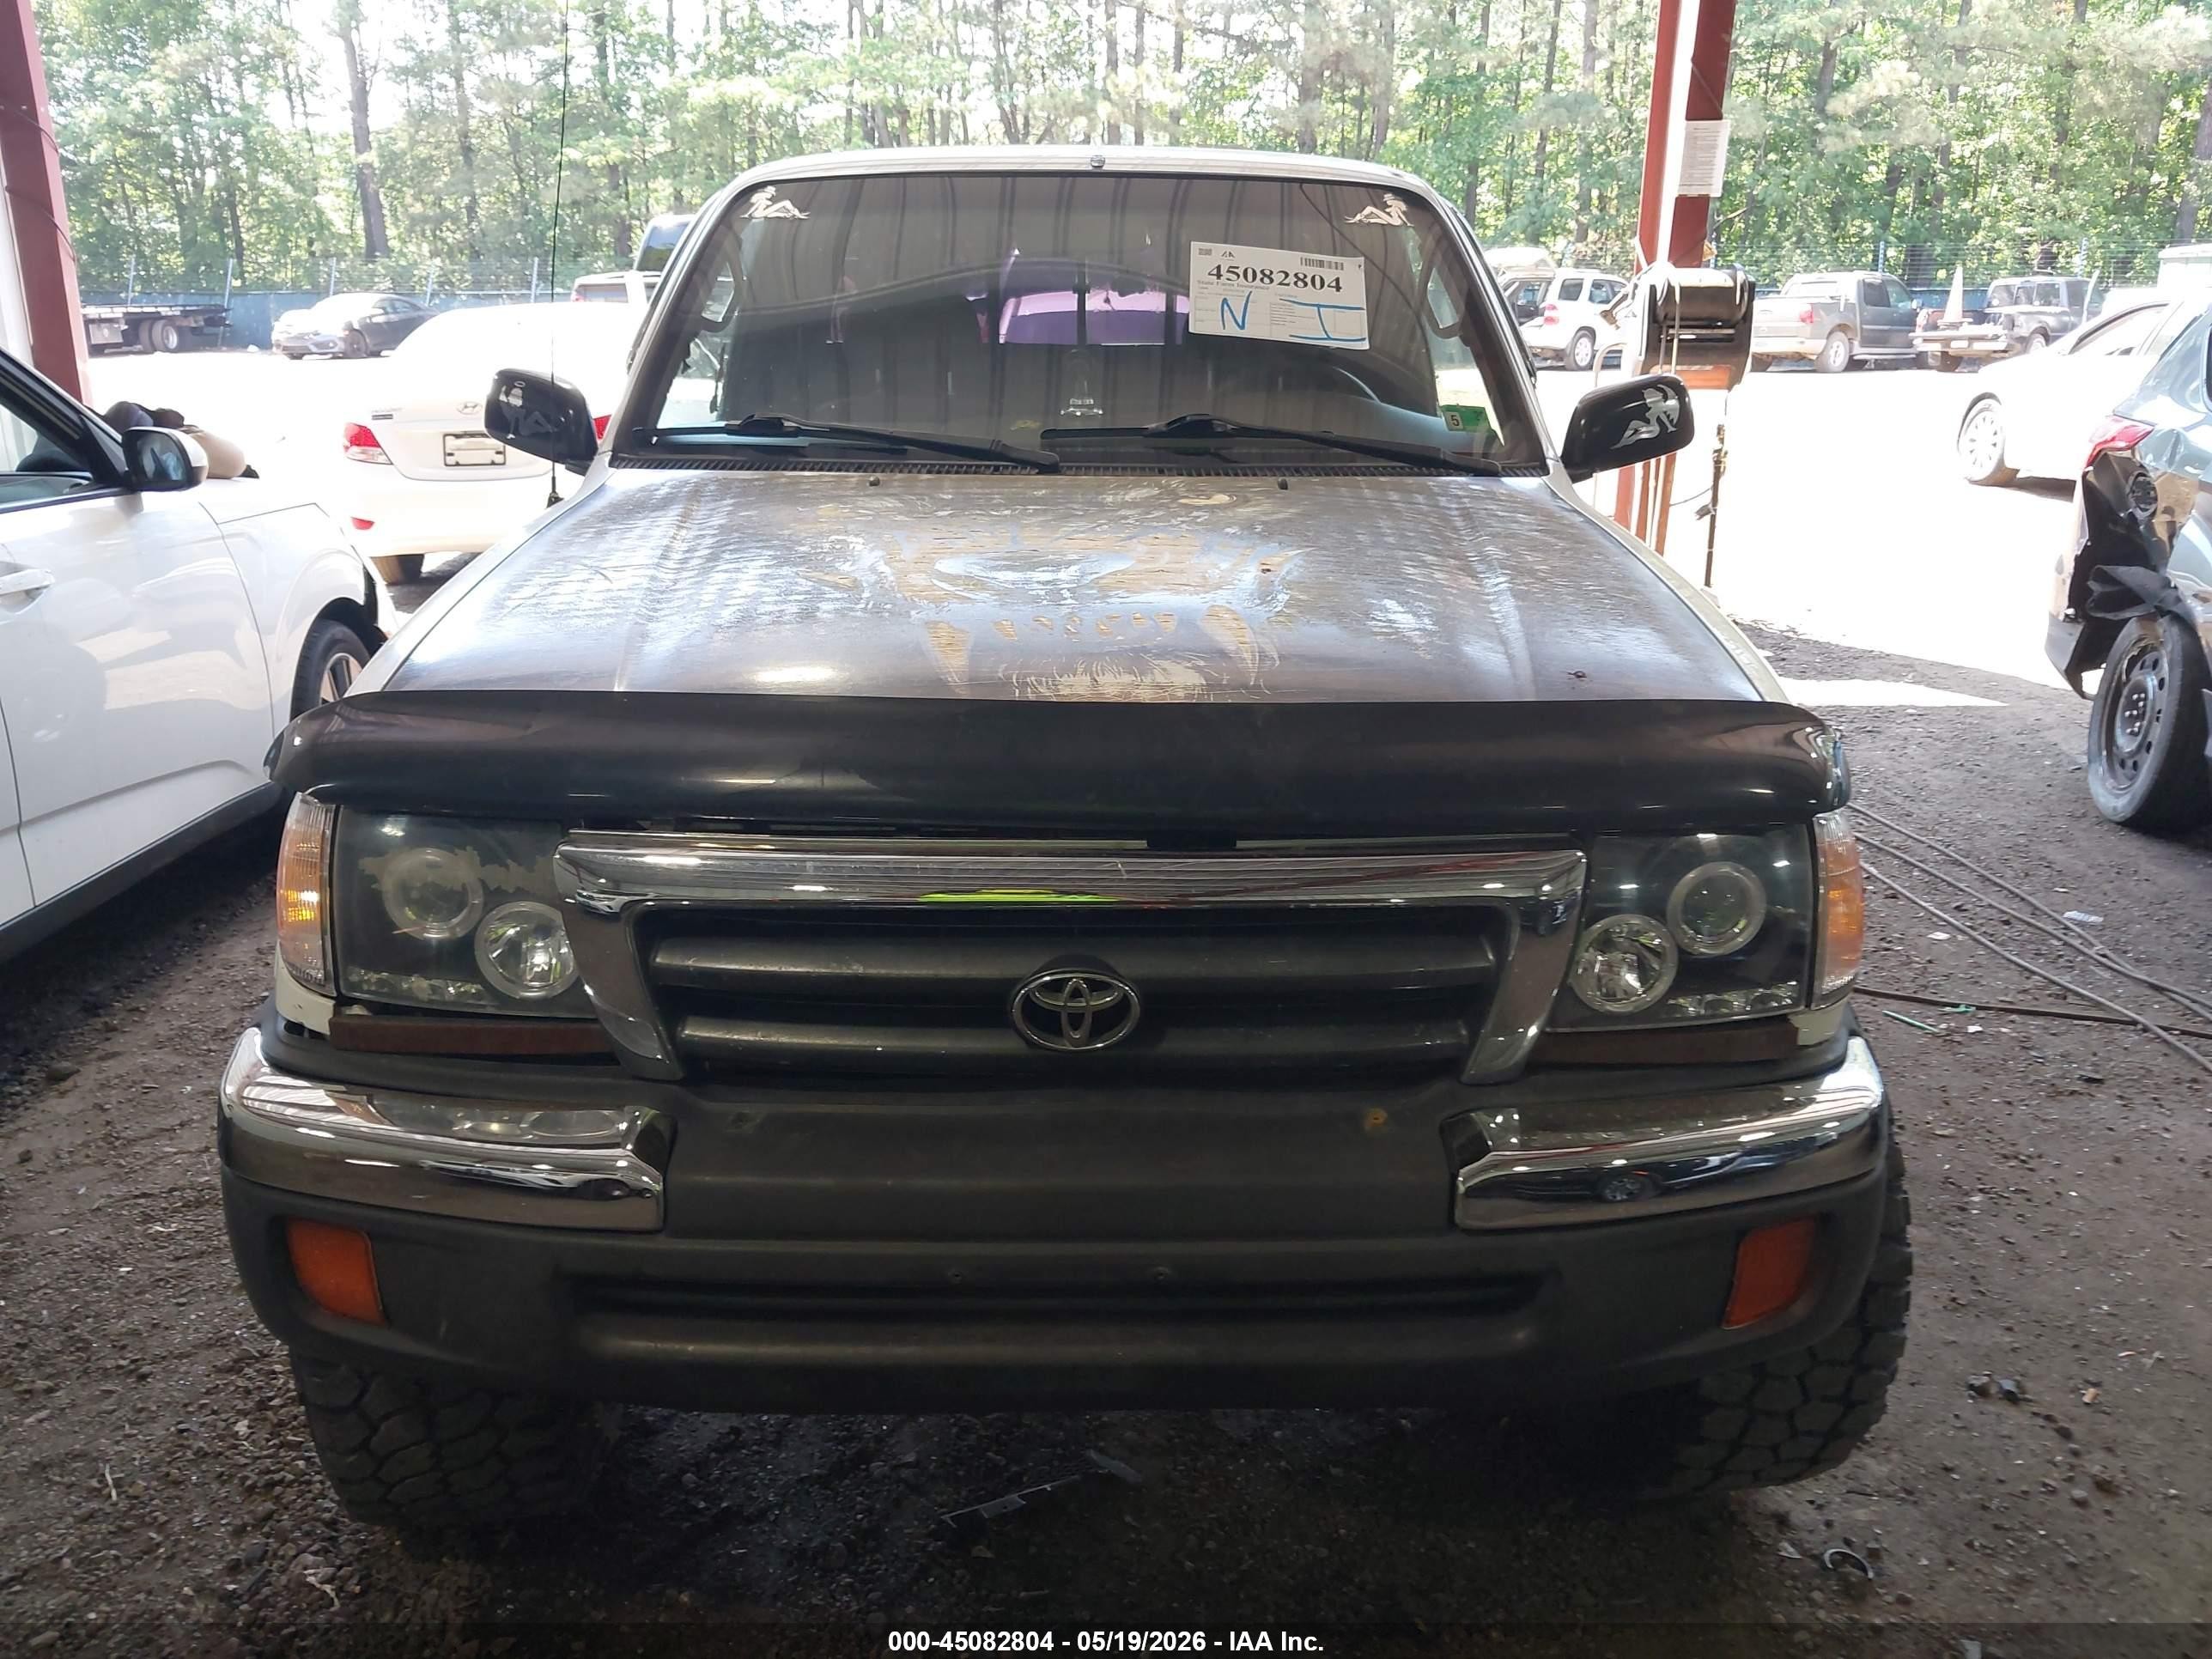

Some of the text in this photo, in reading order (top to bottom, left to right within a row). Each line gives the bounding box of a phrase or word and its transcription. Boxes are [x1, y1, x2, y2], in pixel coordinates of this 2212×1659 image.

[1207, 264, 1343, 293] 45082804
[1220, 290, 1253, 331] N
[1450, 415, 1460, 427] 5
